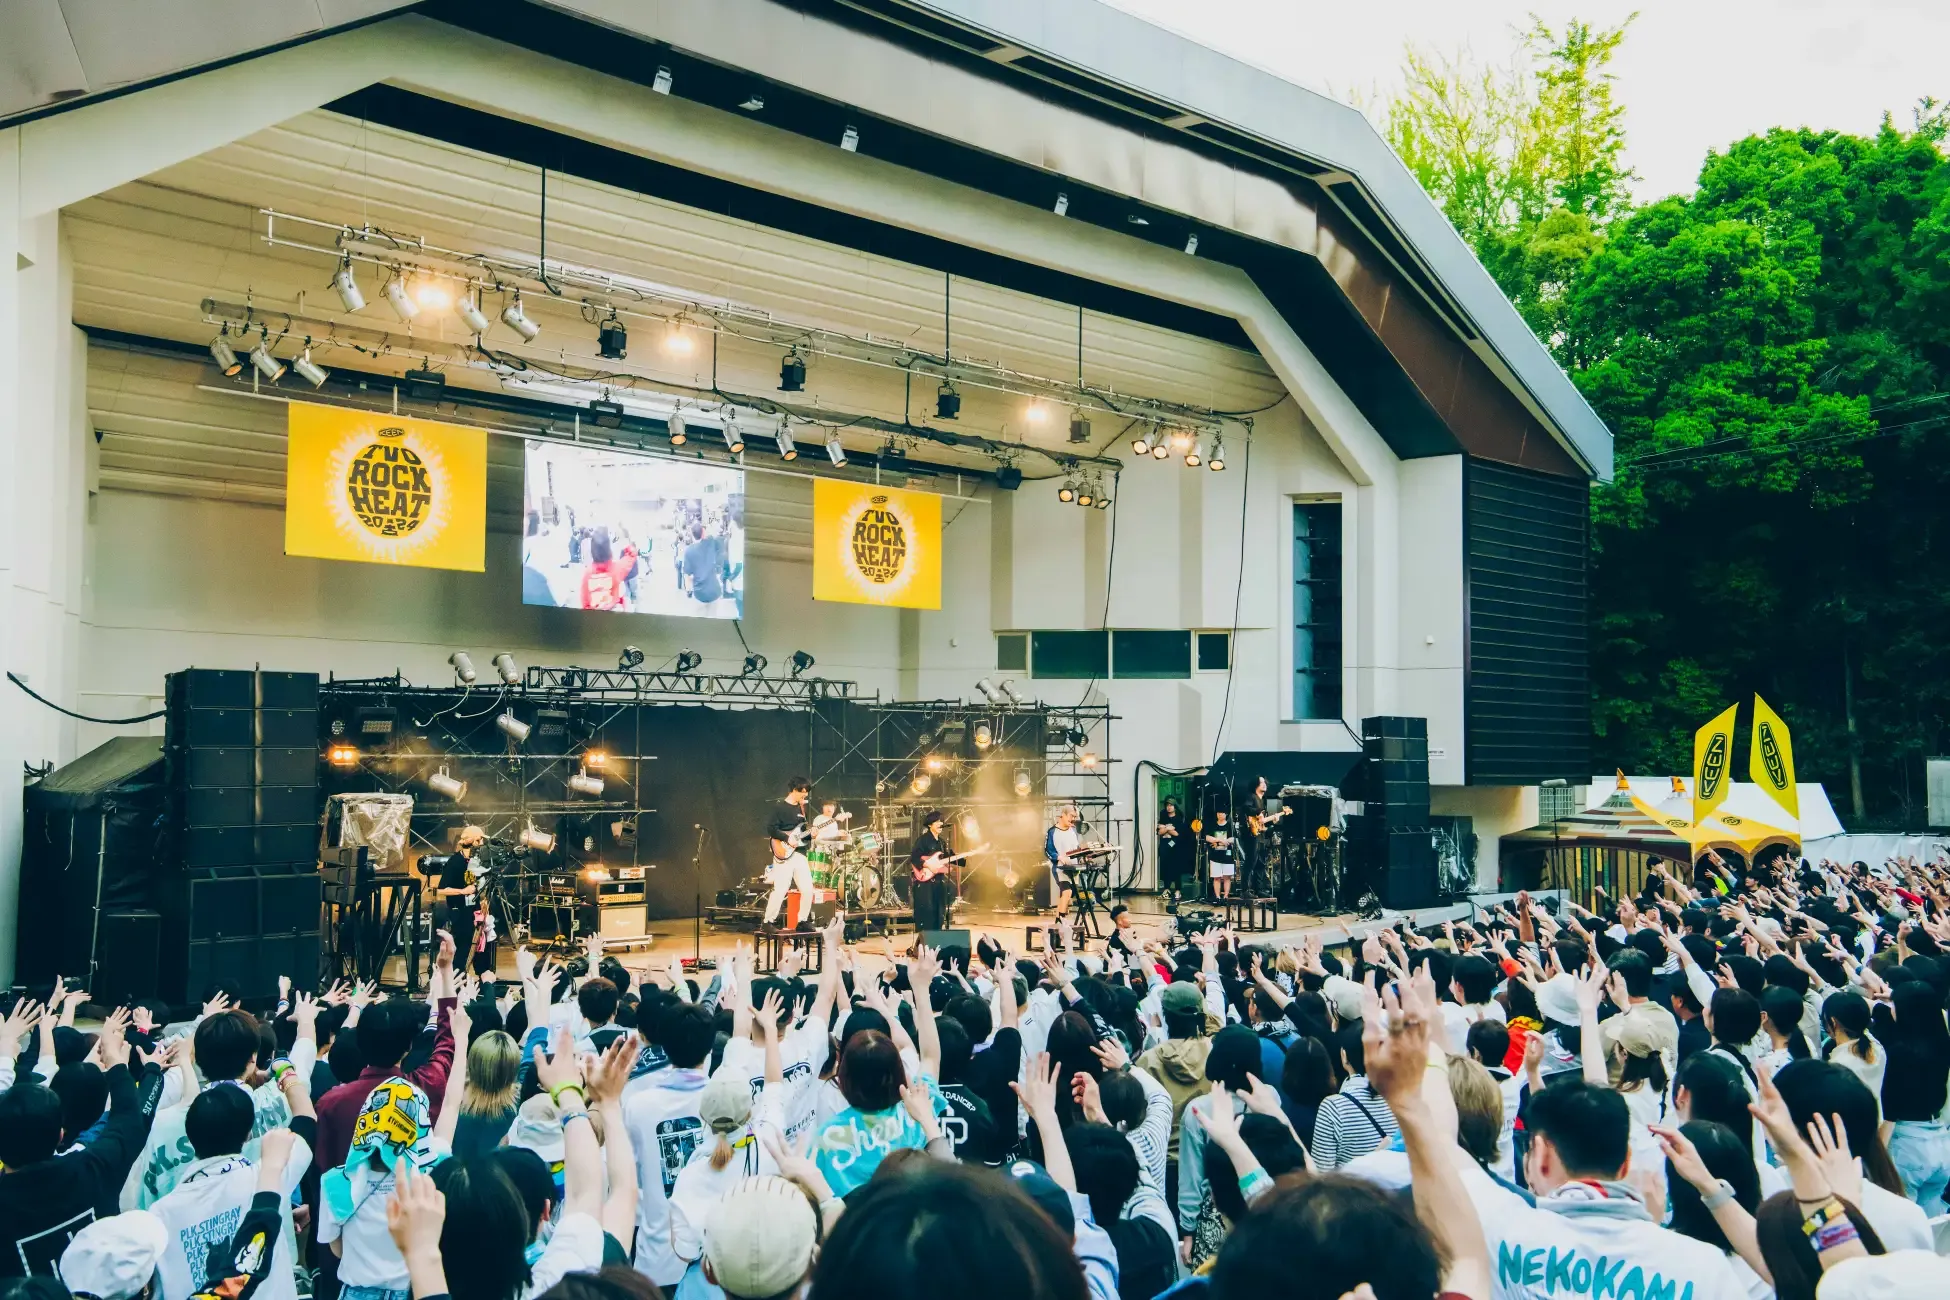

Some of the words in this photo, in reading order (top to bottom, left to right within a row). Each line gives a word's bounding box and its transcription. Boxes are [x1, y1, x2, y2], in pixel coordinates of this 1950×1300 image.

[378, 428, 403, 437] KEEN
[348, 459, 431, 493] ROCK
[348, 486, 431, 518] HEAT
[852, 521, 905, 548] ROCK
[852, 543, 906, 568] HEAT
[1702, 736, 1725, 796] KEEN
[1761, 725, 1784, 787] KEEN
